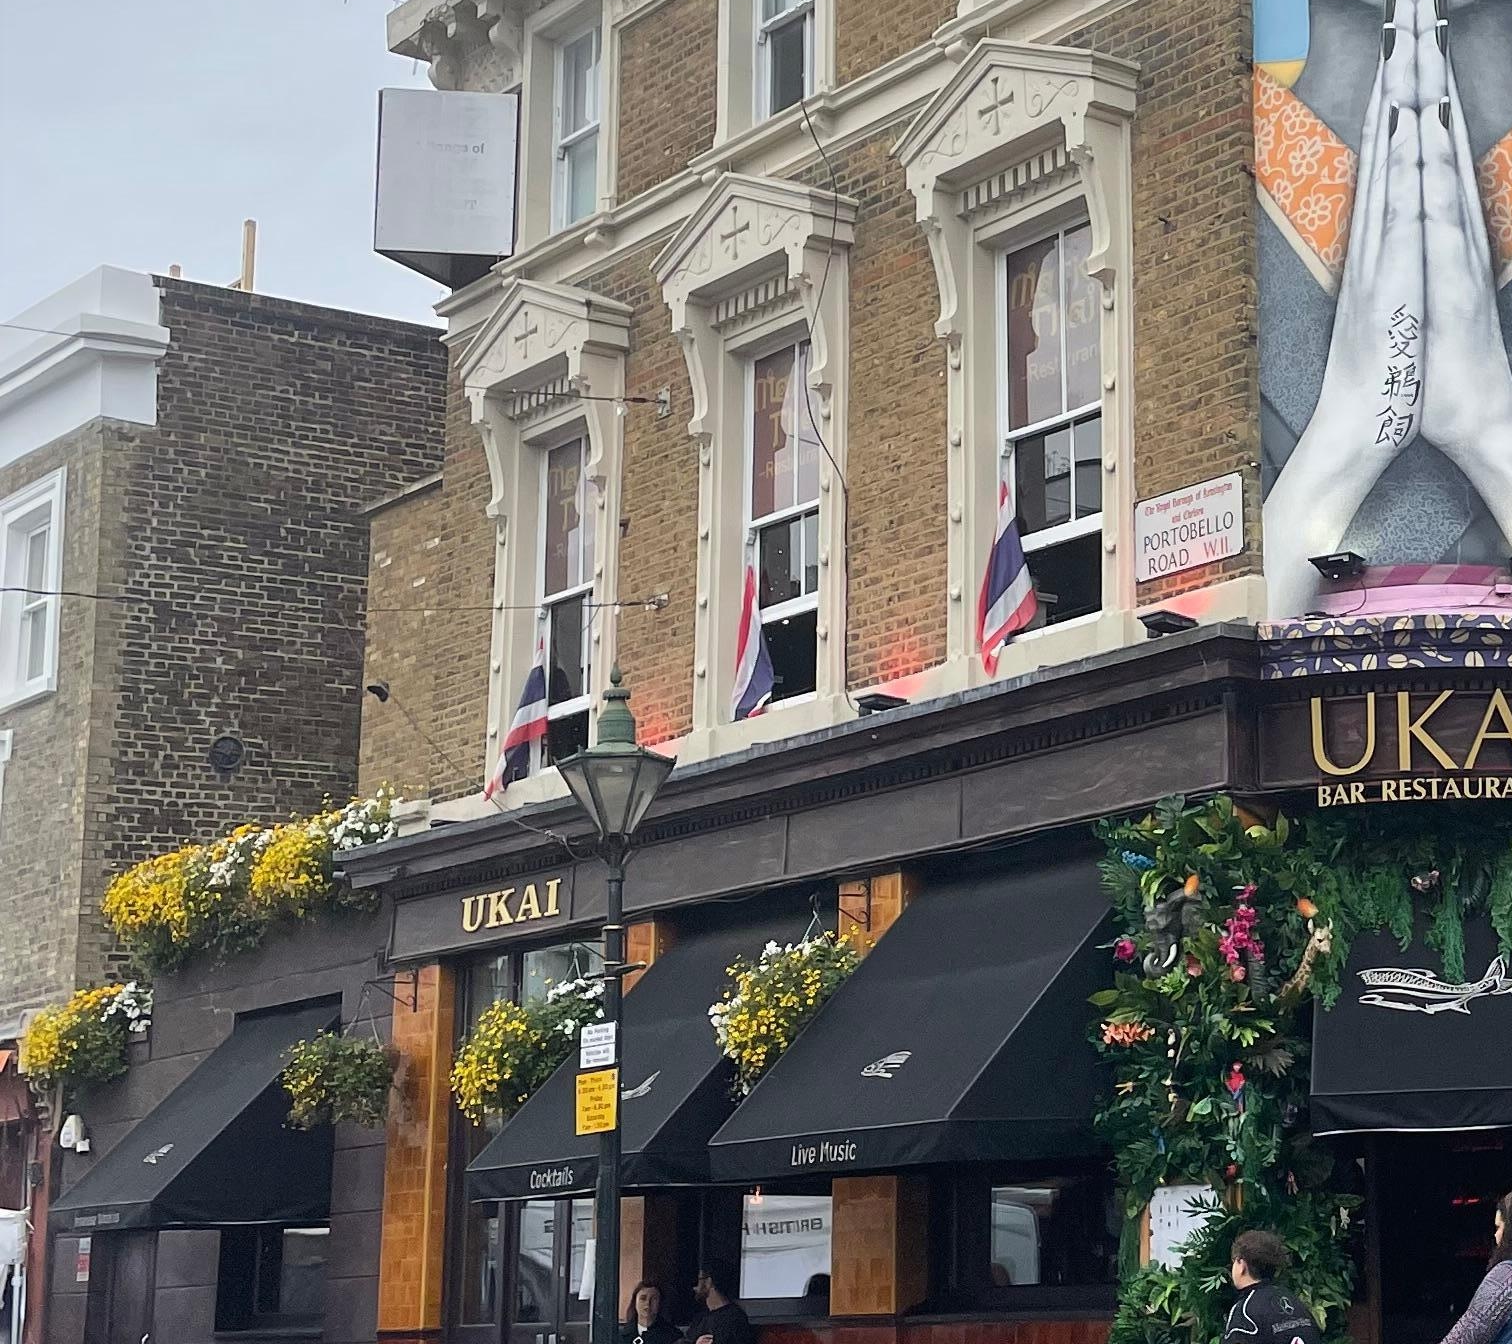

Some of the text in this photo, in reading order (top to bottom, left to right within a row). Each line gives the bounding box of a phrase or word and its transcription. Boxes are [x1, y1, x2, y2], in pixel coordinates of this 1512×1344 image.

[1144, 511, 1233, 554] PORTOBELLO
[1148, 549, 1189, 575] ROAD
[1317, 783, 1366, 807] BAR
[462, 878, 562, 932] UKAI
[791, 1139, 857, 1166] Live Music
[530, 1166, 573, 1189] Cocktails
